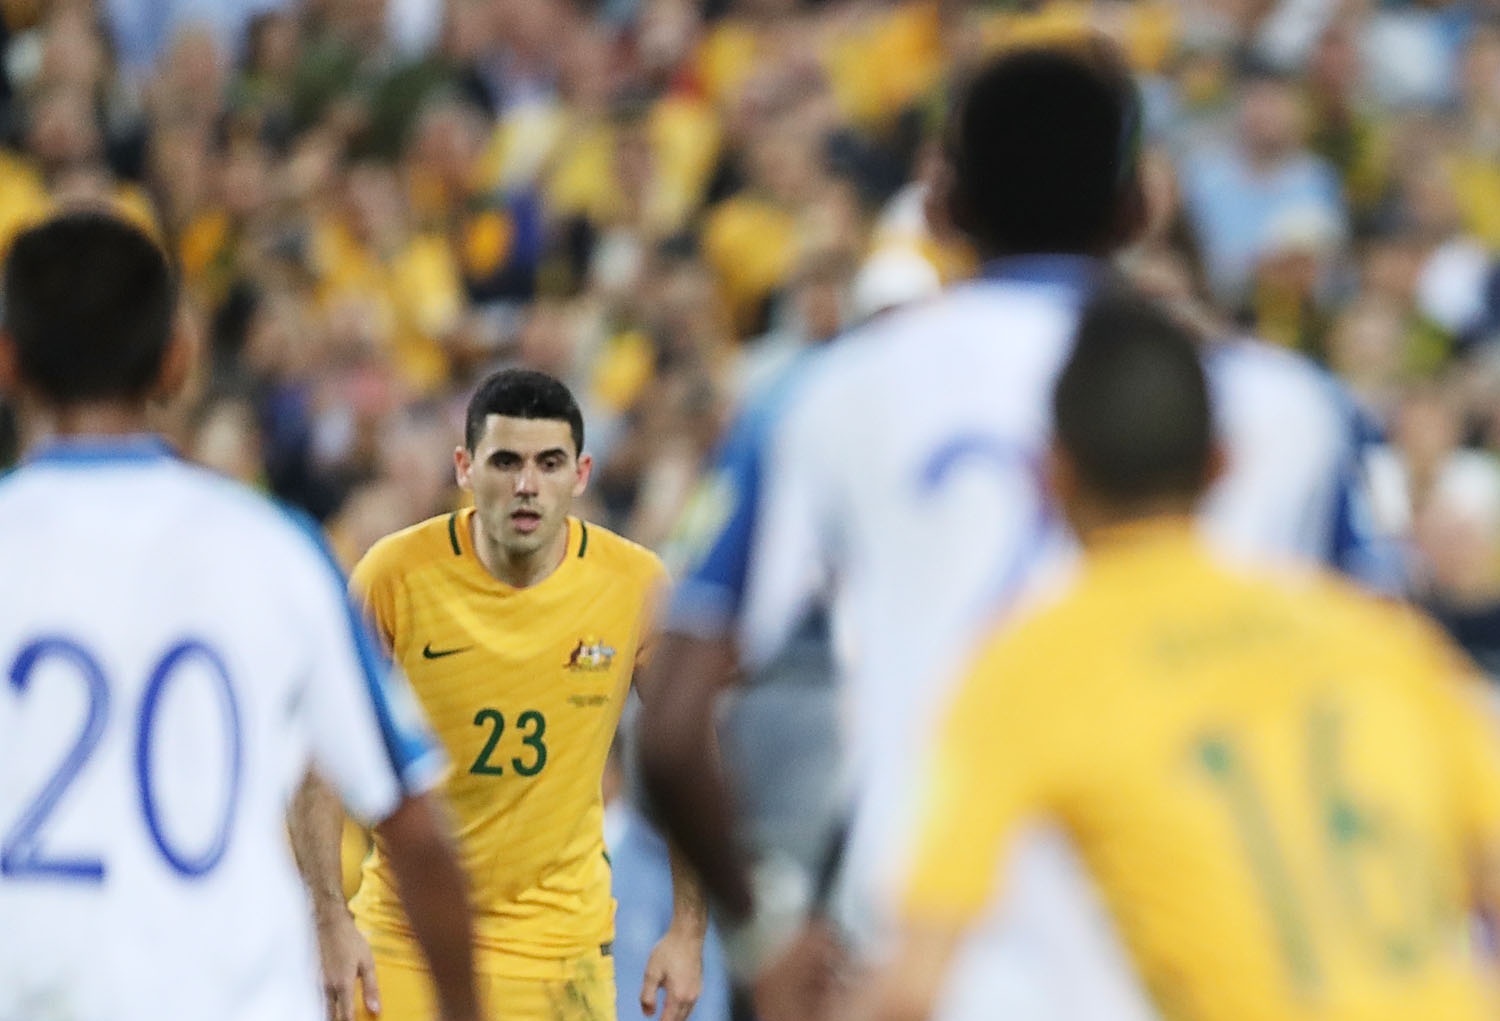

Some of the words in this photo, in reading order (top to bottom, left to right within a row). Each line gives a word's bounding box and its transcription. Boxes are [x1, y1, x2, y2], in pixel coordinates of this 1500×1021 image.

[1, 634, 243, 880] 20
[469, 708, 547, 777] 23
[1186, 690, 1452, 1012] 16
